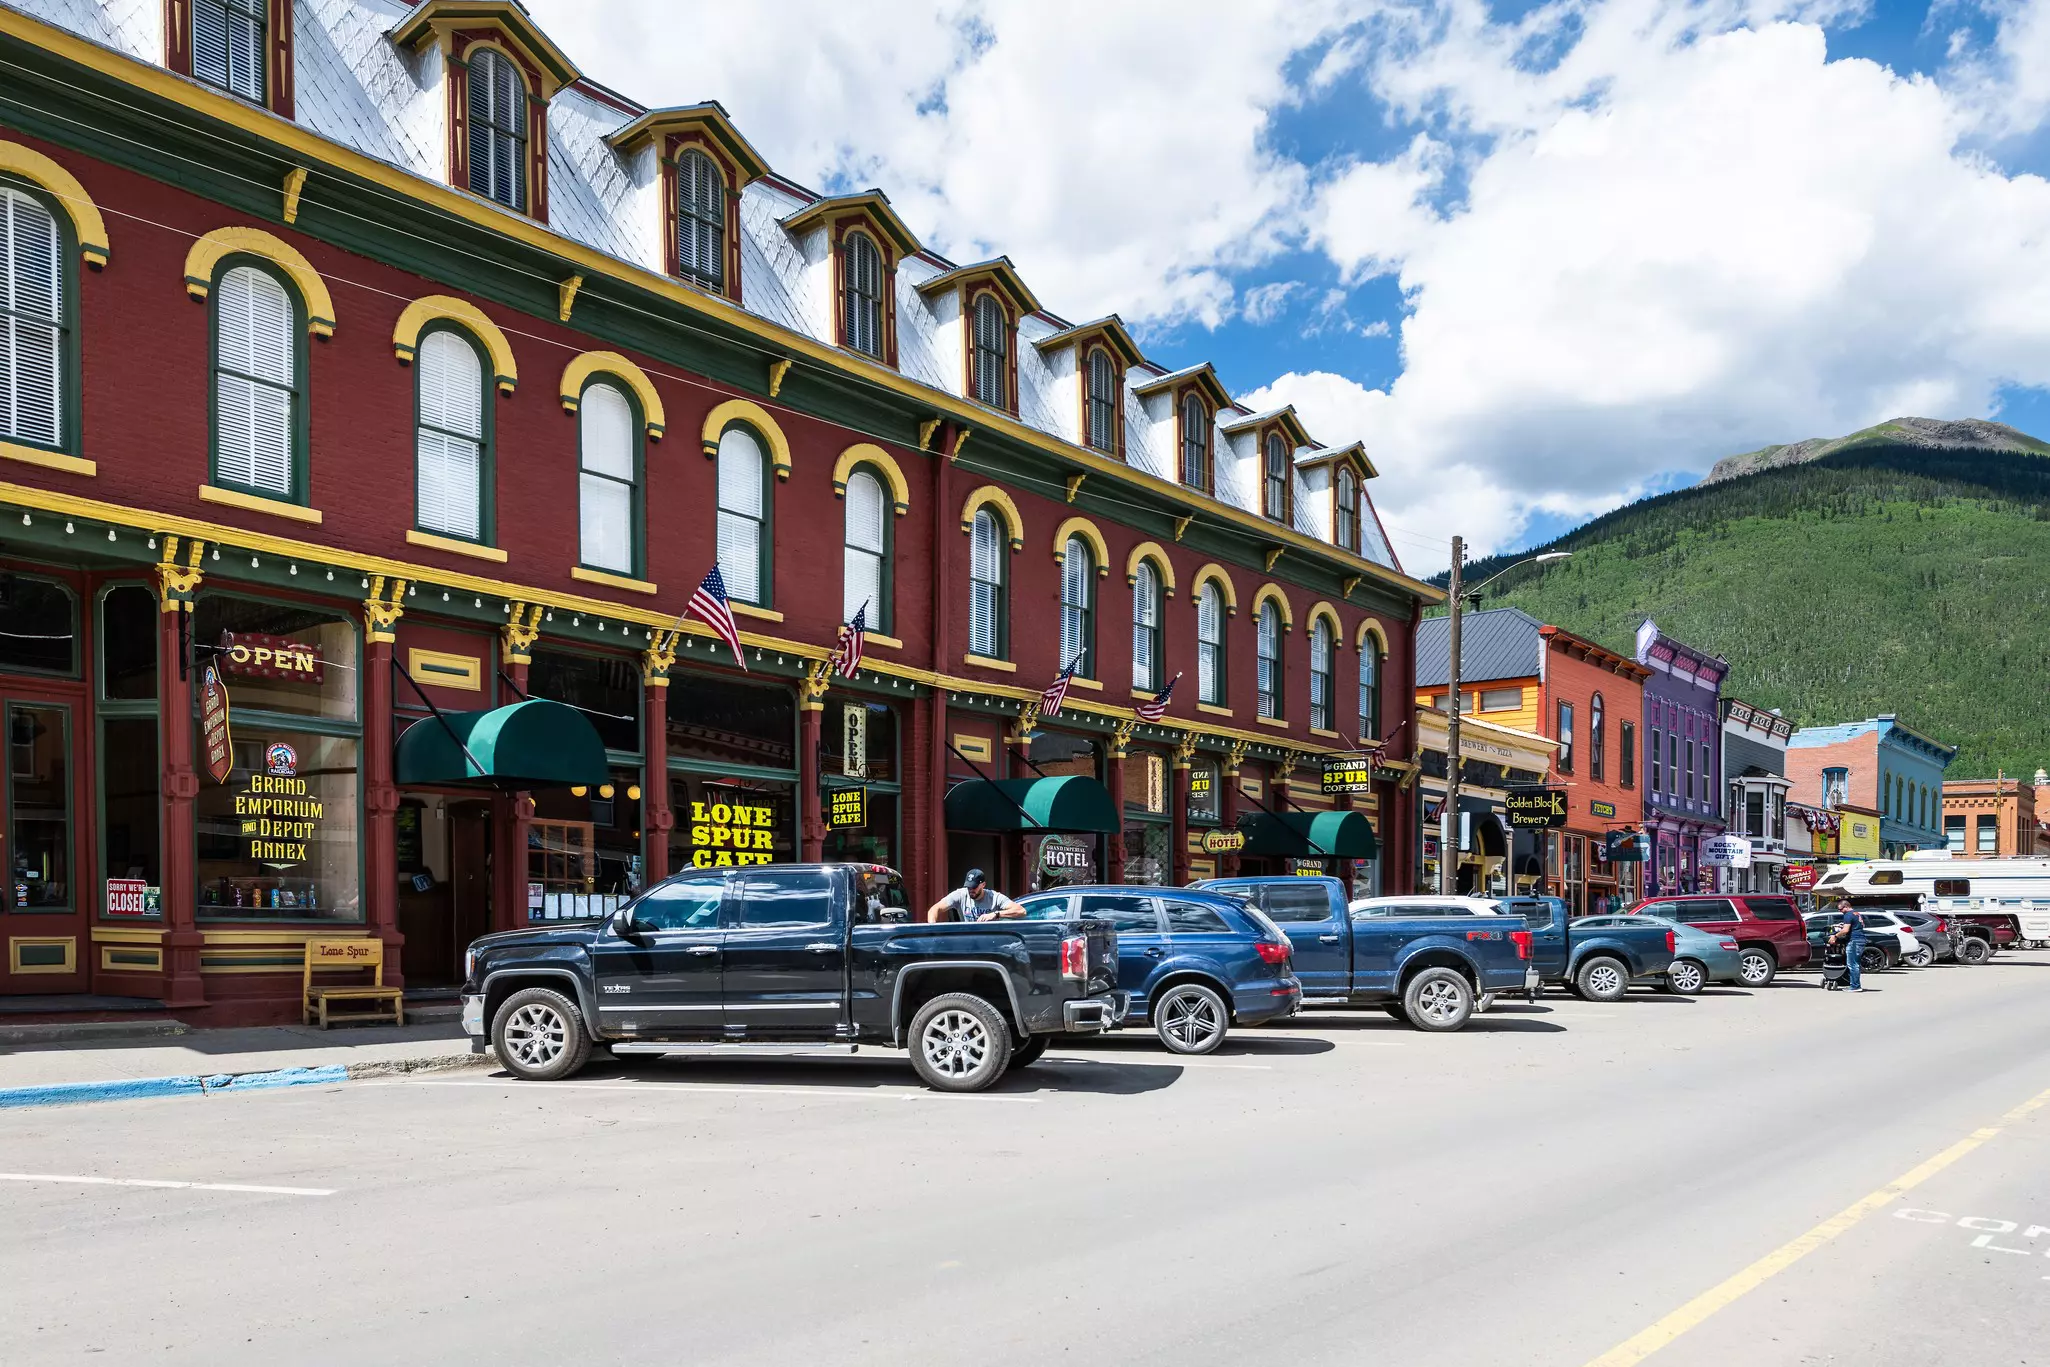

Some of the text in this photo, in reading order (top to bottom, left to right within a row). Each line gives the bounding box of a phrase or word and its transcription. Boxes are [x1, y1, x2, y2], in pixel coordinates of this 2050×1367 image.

[230, 645, 314, 672] OPEN
[848, 713, 859, 772] OPEN
[1497, 748, 1512, 758] PIZZA
[1334, 761, 1366, 770] GRAND
[1324, 771, 1367, 783] SPUR
[252, 775, 306, 795] GRAND
[1324, 784, 1367, 792] COFFEE
[832, 792, 860, 803] LONE
[1506, 797, 1533, 808] Golden
[236, 796, 323, 819] EMPORIUM
[833, 803, 861, 814] SPUR
[691, 802, 772, 826] LONE
[833, 813, 860, 824] CAFE
[1513, 812, 1550, 825] Brewery
[242, 819, 315, 839] AND DEPOT
[692, 826, 773, 849] SPUR
[1210, 839, 1241, 848] HOTEL
[251, 840, 306, 861] ANNEX
[1046, 851, 1088, 867] HOTEL
[1302, 860, 1322, 868] GRAND
[1784, 870, 1812, 880] MINERALS
[1792, 875, 1811, 883] GIFTS
[109, 883, 126, 892] SORRY
[128, 884, 145, 892] WE'RE
[109, 893, 144, 912] CLOSED
[320, 945, 369, 958] Lone Spur
